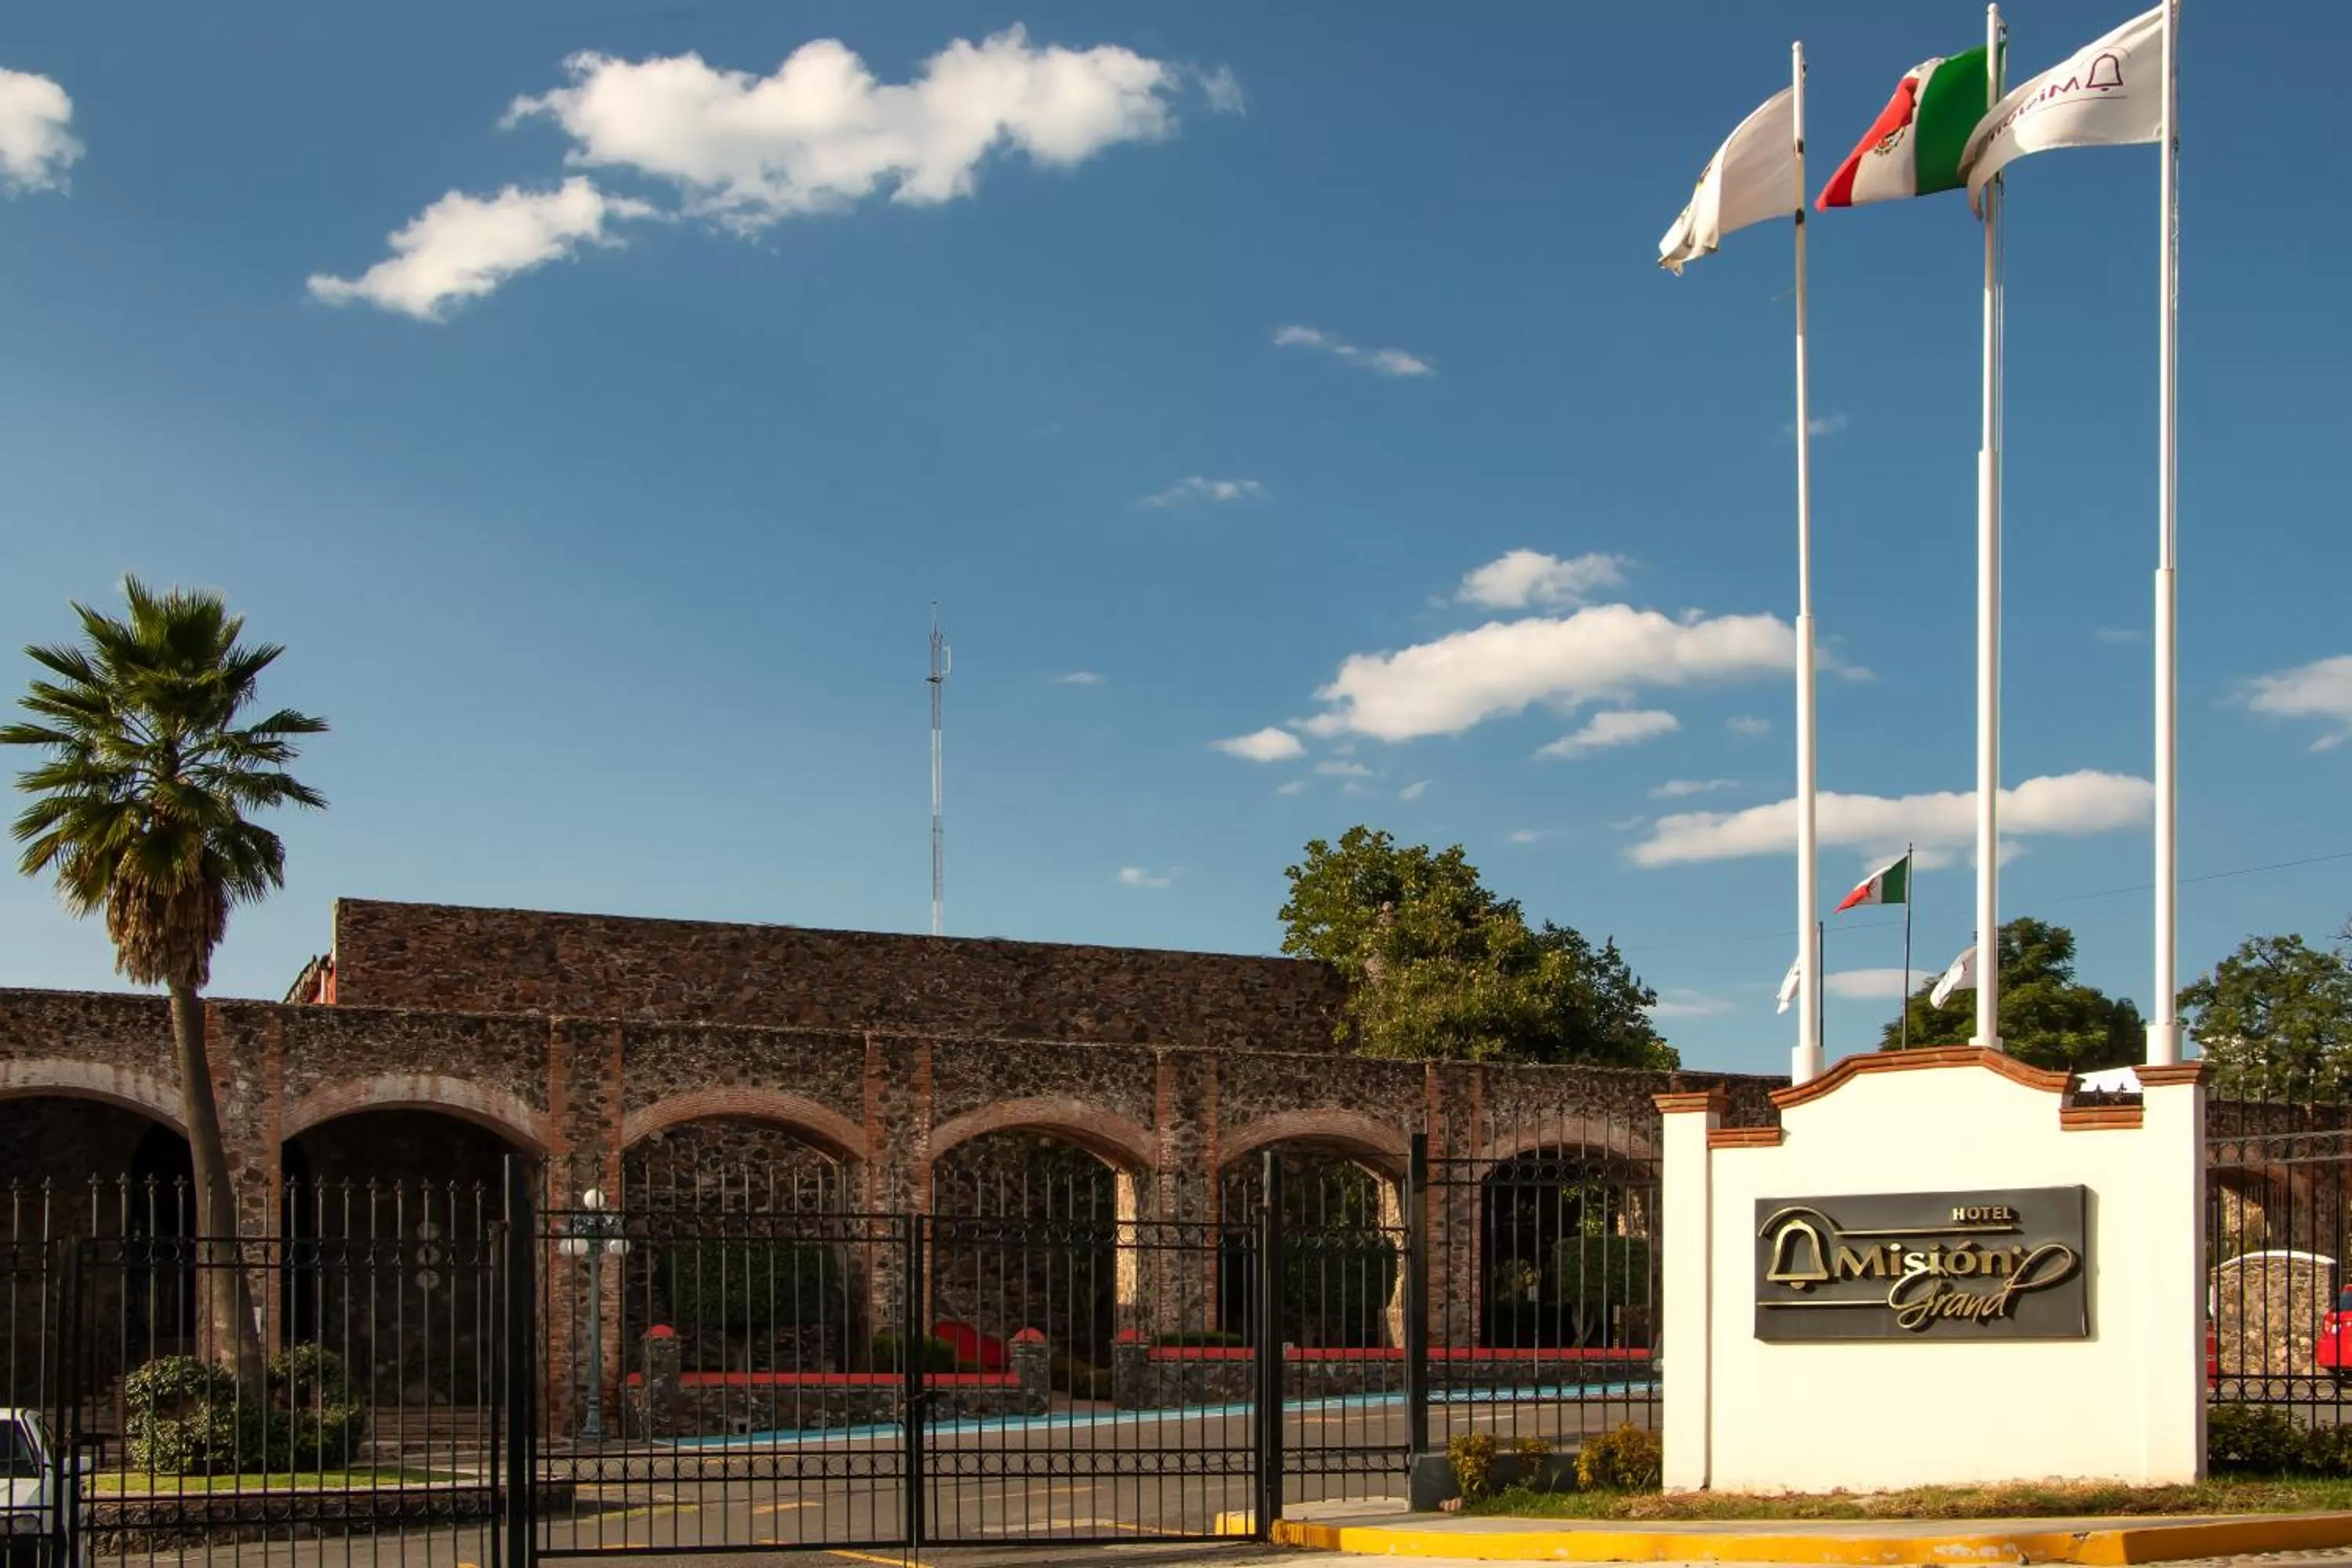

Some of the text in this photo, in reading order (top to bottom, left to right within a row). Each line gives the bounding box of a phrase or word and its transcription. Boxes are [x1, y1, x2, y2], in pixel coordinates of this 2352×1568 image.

[1952, 1207, 2013, 1221] HOTEL
[1834, 1240, 2013, 1276] Misión
[1887, 1243, 2074, 1329] Grand
